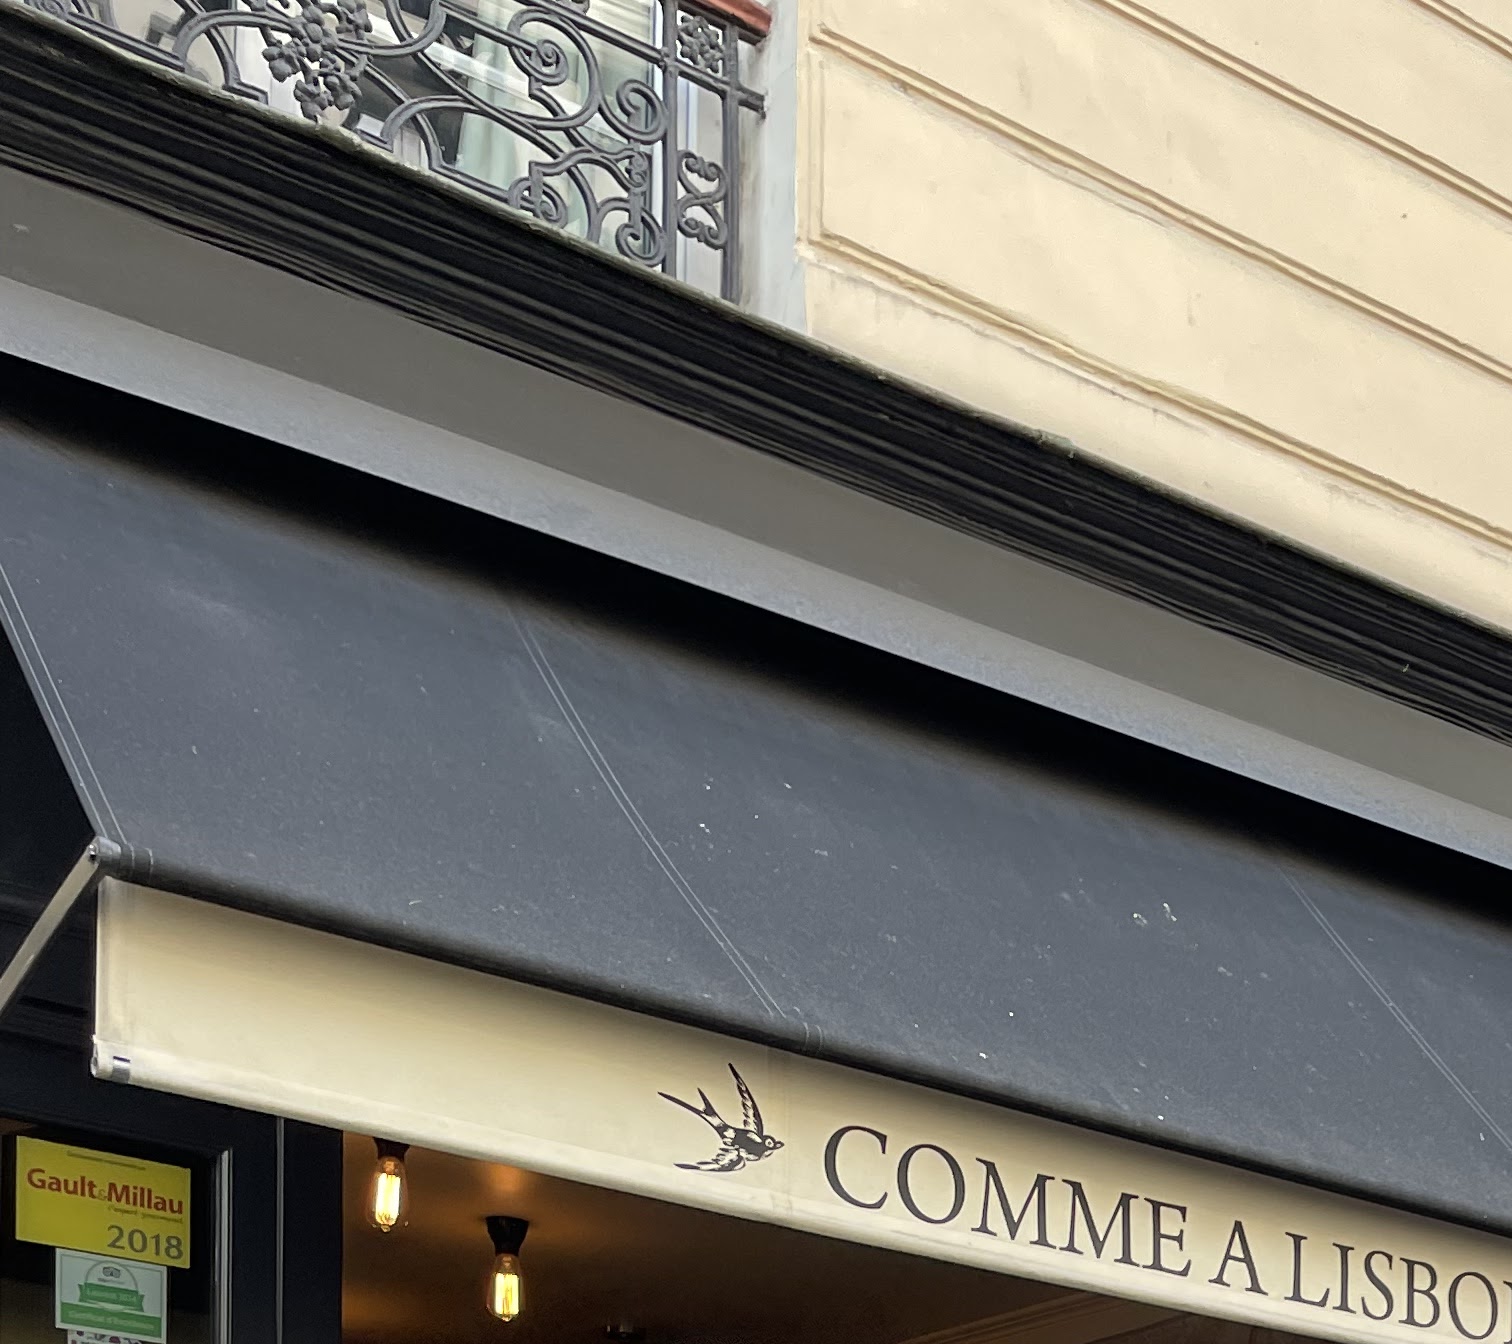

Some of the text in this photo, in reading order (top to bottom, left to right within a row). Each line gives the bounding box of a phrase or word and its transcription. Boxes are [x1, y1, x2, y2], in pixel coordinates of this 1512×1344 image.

[107, 1225, 183, 1260] 2018
[823, 1125, 1193, 1278] COMME
[1208, 1220, 1268, 1297] A
